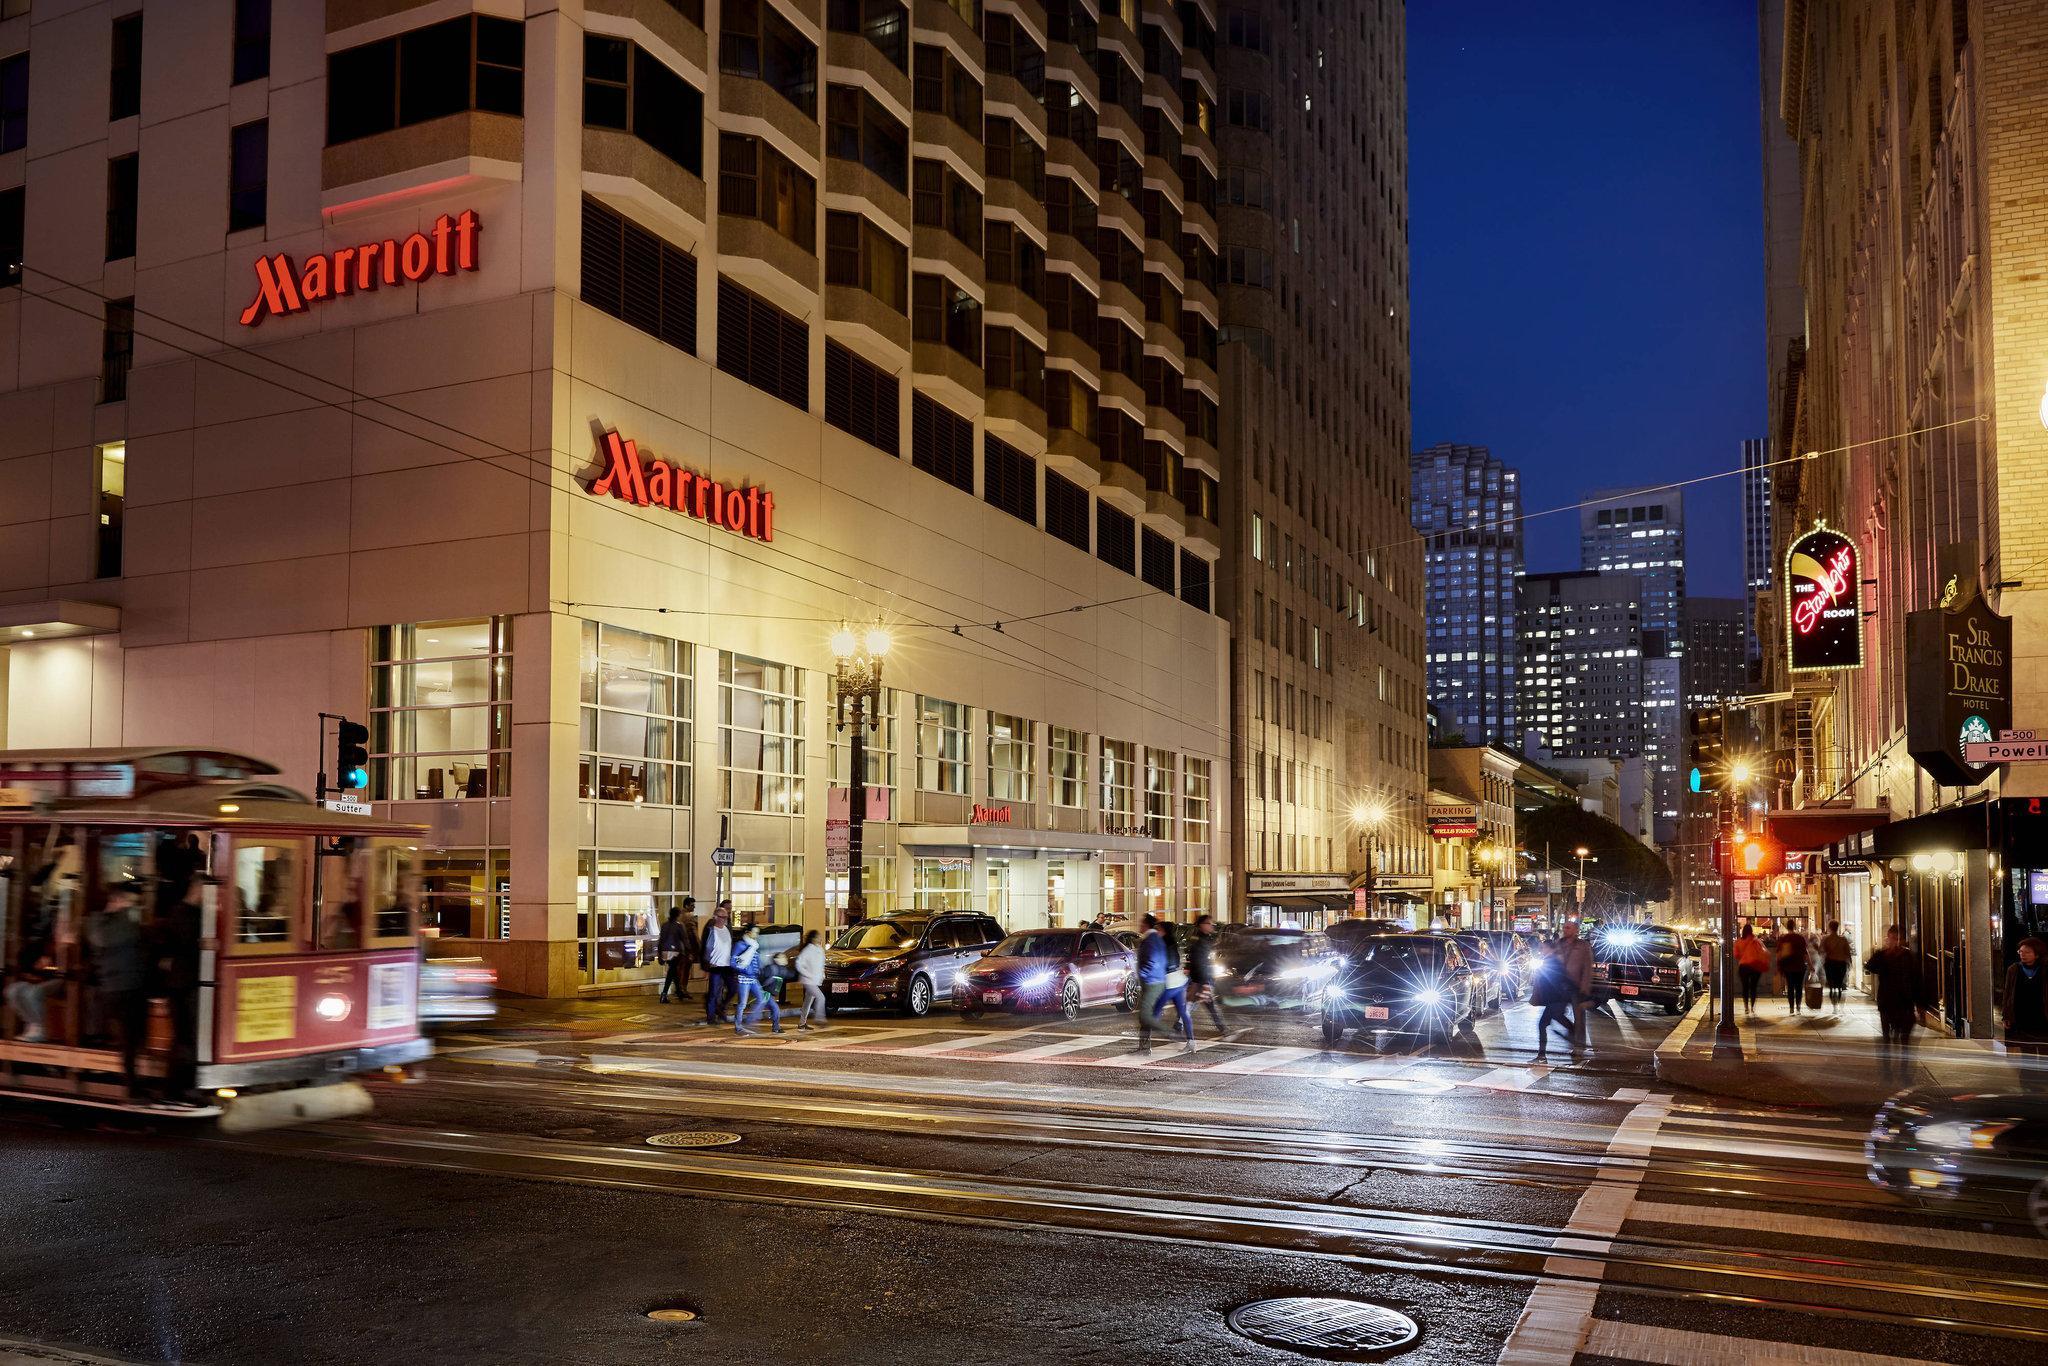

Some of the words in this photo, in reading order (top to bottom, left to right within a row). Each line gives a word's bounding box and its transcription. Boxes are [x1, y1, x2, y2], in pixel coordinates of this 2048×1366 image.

[240, 209, 481, 325] Marriott
[590, 430, 773, 541] Marriott
[1794, 584, 1816, 593] THE
[1795, 546, 1851, 633] Starlight
[1823, 608, 1855, 618] ROOM
[1948, 633, 2003, 667] FRANCIS
[1953, 663, 2000, 694] DRAKE
[1963, 699, 1990, 710] HOTEL
[2012, 731, 2033, 740] 500
[335, 803, 363, 813] Sutter
[970, 803, 1012, 825] Marriott
[1431, 807, 1472, 815] PARKING
